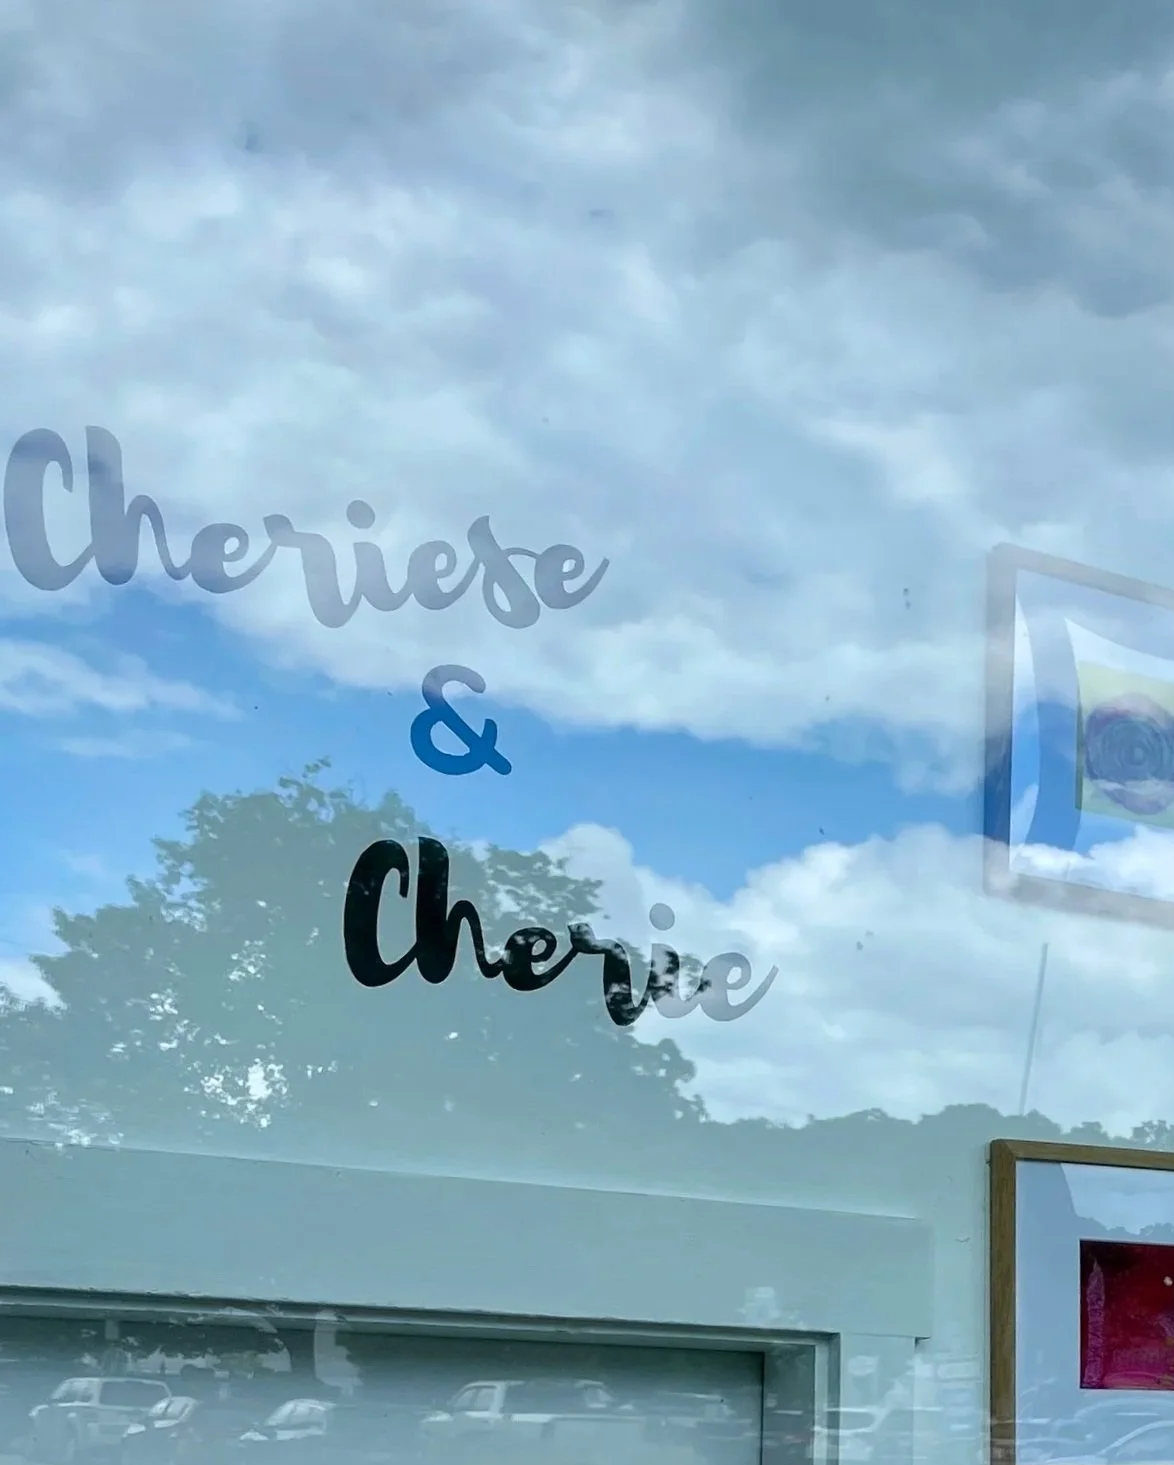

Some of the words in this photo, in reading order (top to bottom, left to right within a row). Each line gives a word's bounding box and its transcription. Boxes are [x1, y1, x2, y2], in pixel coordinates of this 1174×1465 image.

[4, 425, 609, 629] Cheriese
[410, 664, 512, 776] &
[343, 836, 779, 1026] Cherie
